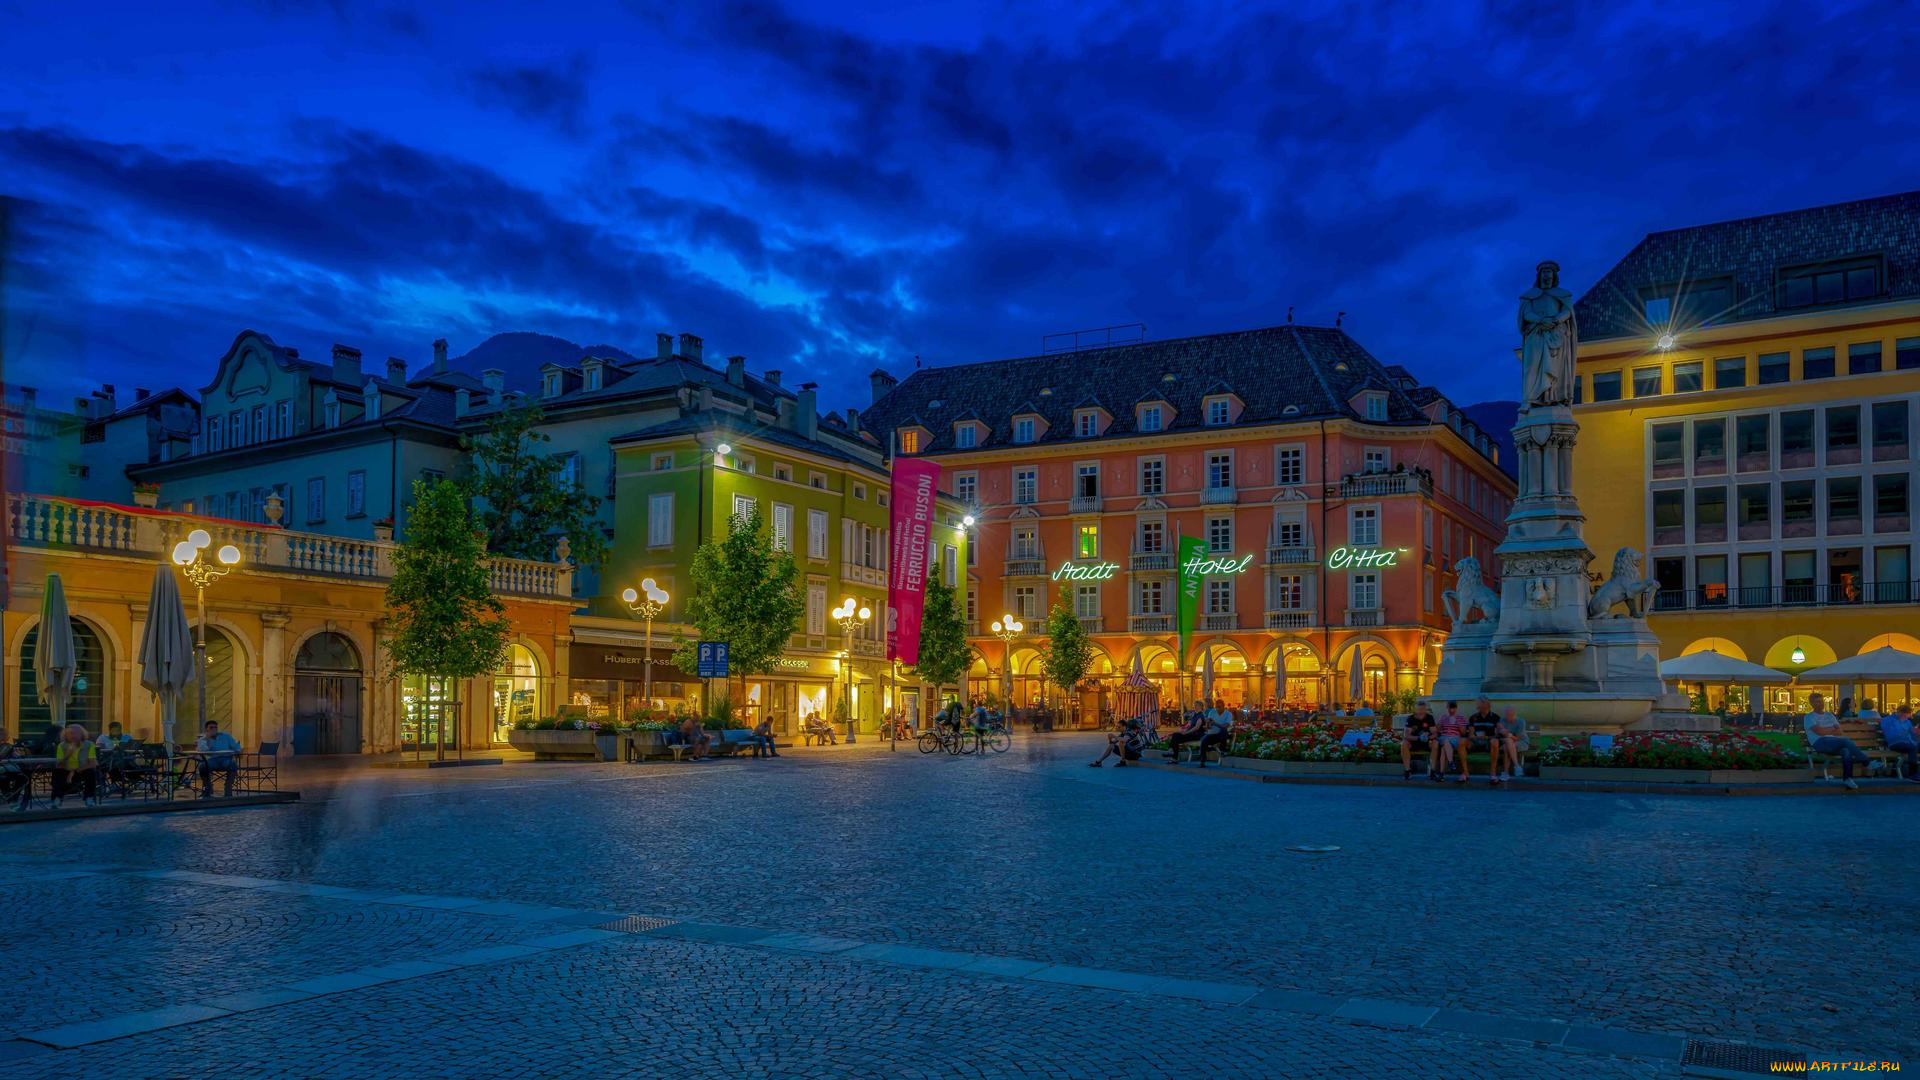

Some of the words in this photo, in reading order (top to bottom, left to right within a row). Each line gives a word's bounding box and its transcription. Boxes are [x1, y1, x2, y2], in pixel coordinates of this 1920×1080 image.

[915, 474, 932, 520] BUSONI
[906, 524, 926, 592] FERRUCCIO
[1052, 561, 1120, 581] Stadt
[1183, 554, 1253, 574] Hotel
[604, 655, 641, 664] HUBERT
[701, 647, 711, 662] P
[716, 647, 726, 662] P
